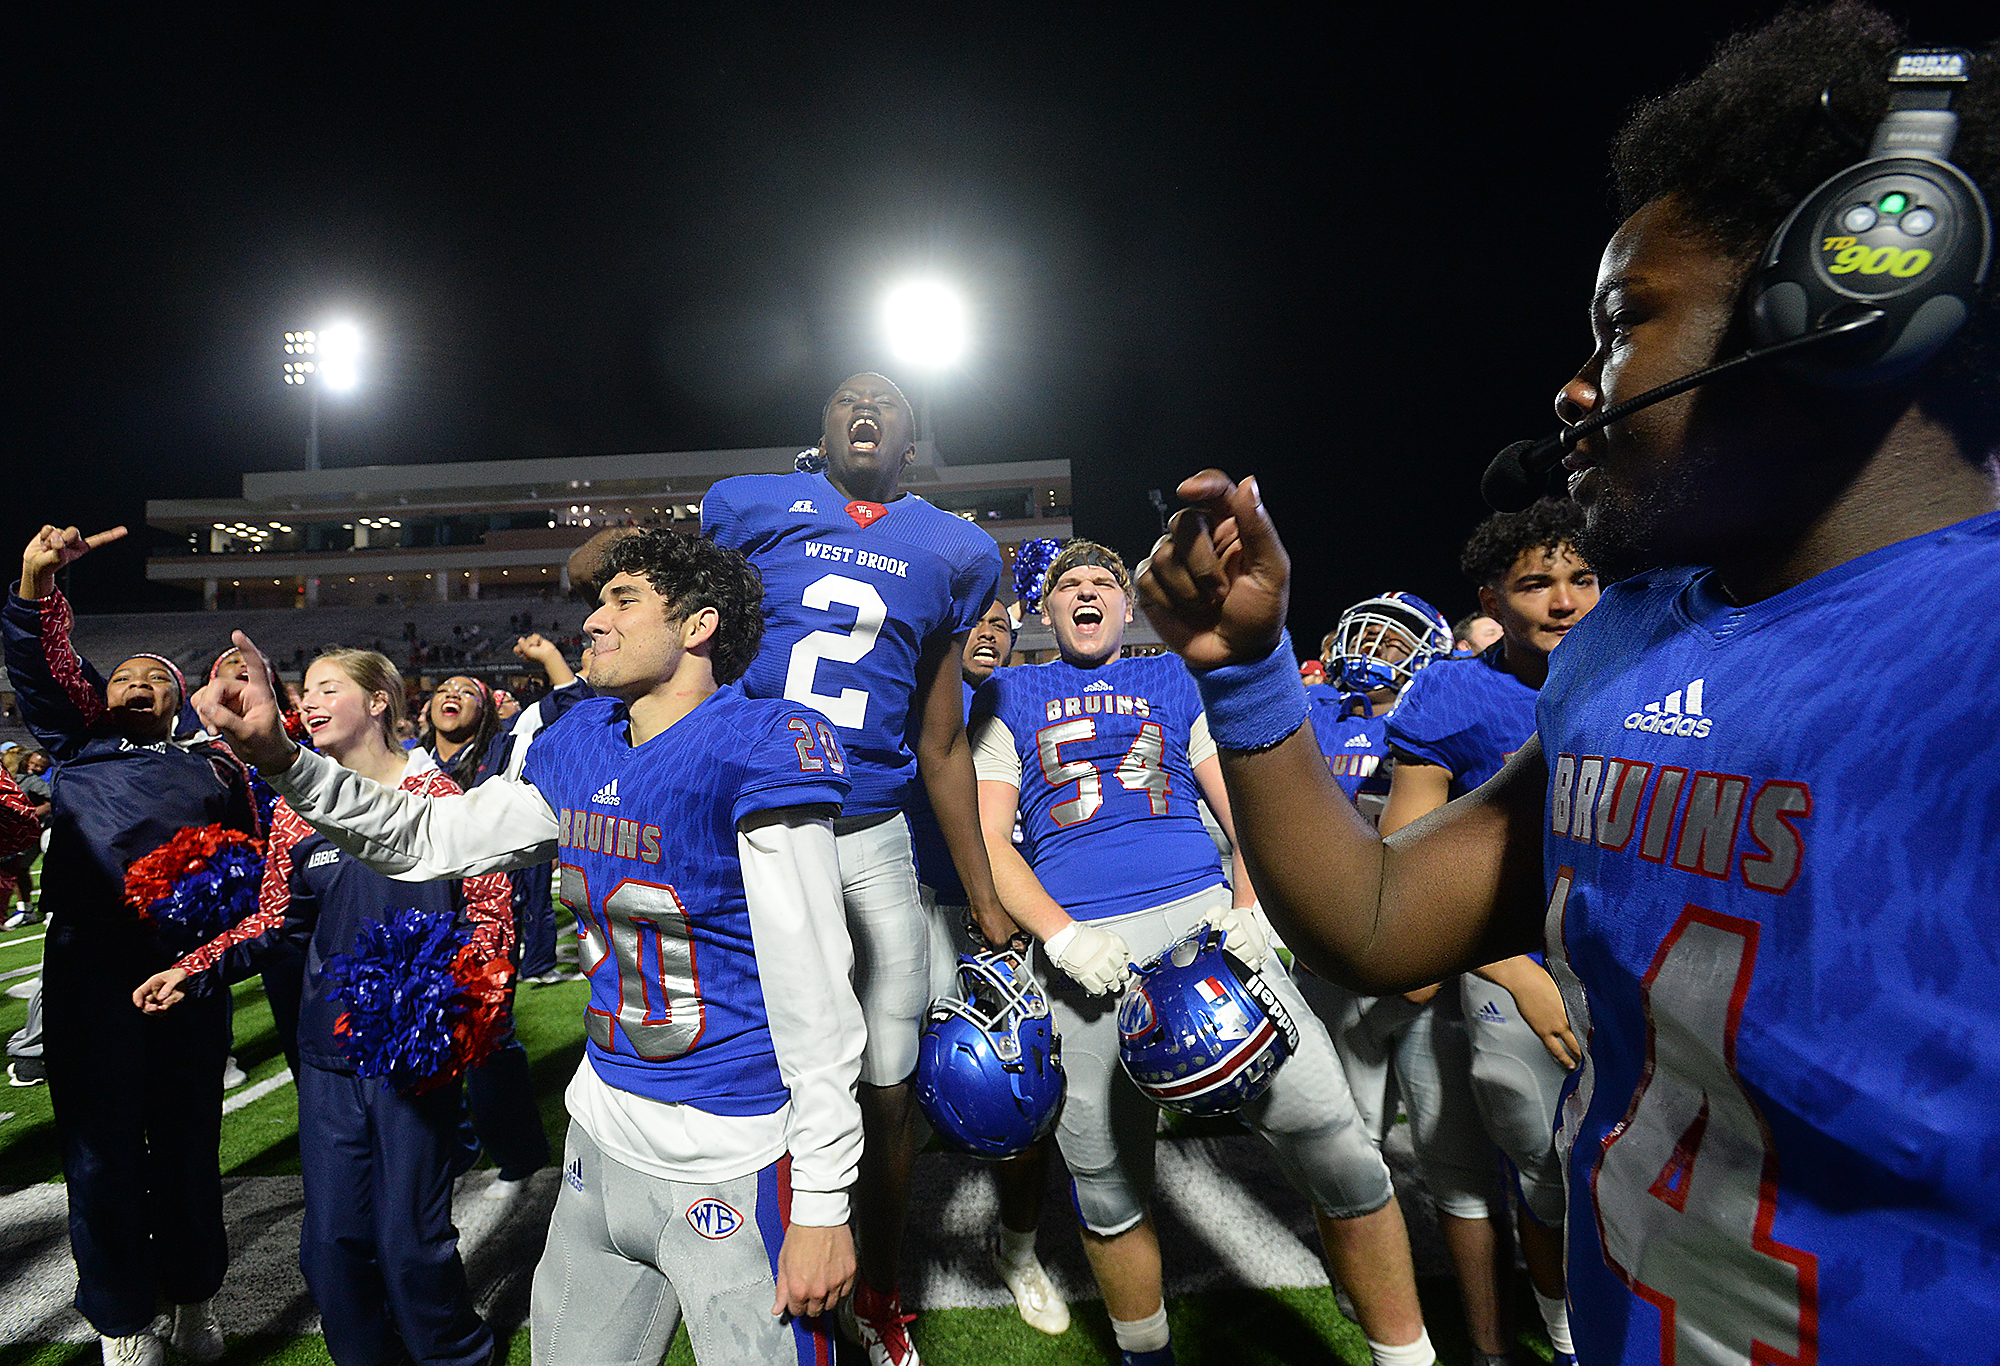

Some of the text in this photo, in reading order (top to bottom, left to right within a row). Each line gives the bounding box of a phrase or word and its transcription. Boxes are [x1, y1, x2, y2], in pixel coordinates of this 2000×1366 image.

[1898, 54, 1963, 67] PORTA
[1823, 236, 1857, 251] TD
[1827, 245, 1933, 278] 900
[856, 504, 873, 518] WB
[804, 541, 910, 578] WEST BROOK
[782, 572, 889, 731] 2
[1045, 694, 1151, 722] BRUINS
[1623, 711, 1714, 739] adidas
[787, 717, 846, 775] 20
[1035, 716, 1173, 829] 54
[591, 792, 621, 807] adidas
[557, 807, 663, 865] BRUINS
[1551, 751, 1814, 897] BRUINS
[559, 862, 707, 1060] 20
[1245, 974, 1301, 1051] Riddell
[690, 1203, 736, 1235] WB
